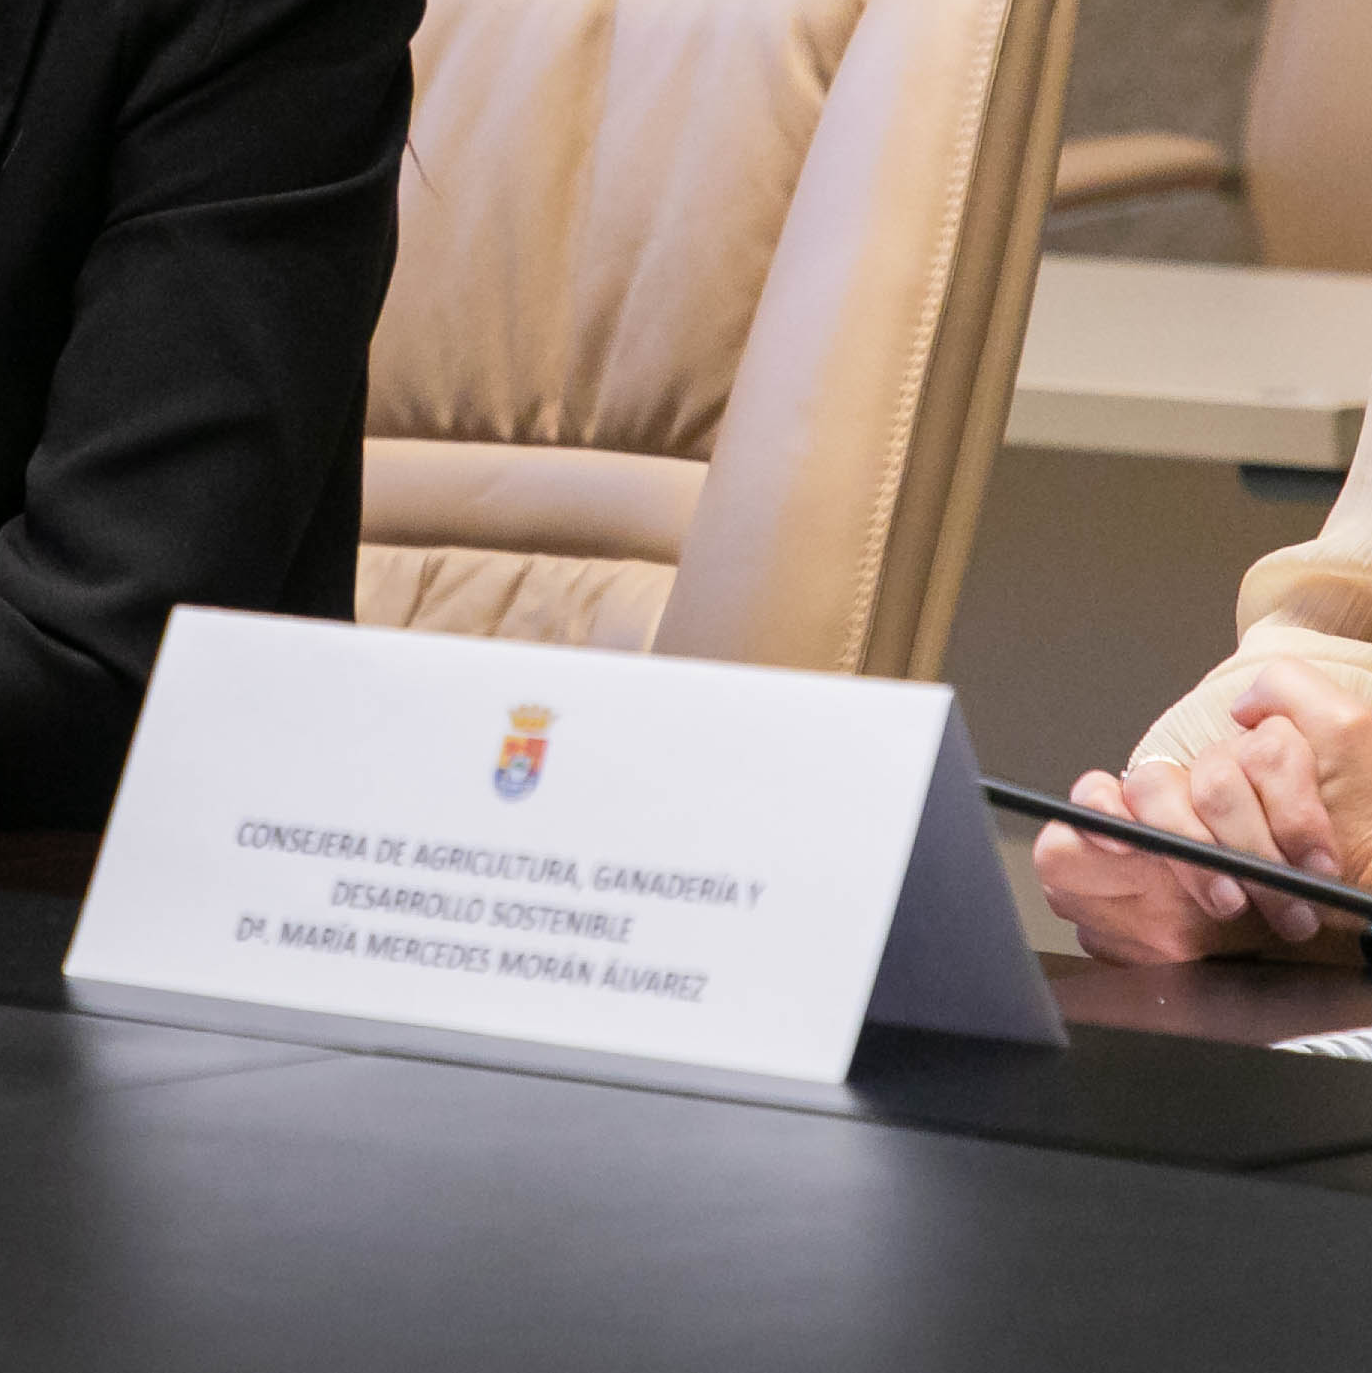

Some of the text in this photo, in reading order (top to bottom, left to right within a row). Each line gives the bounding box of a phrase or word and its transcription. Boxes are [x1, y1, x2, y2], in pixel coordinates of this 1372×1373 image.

[236, 820, 765, 908] CONSEJERA DE AGRICULTURA, GANADERÍA Y
[331, 881, 635, 944] DESARROLLO SOSTENIBLE
[279, 920, 358, 956] MARÍA
[365, 933, 490, 974] MERCEDES
[497, 946, 595, 985] MORÁN
[601, 958, 708, 1003] ÁLVAREZ
